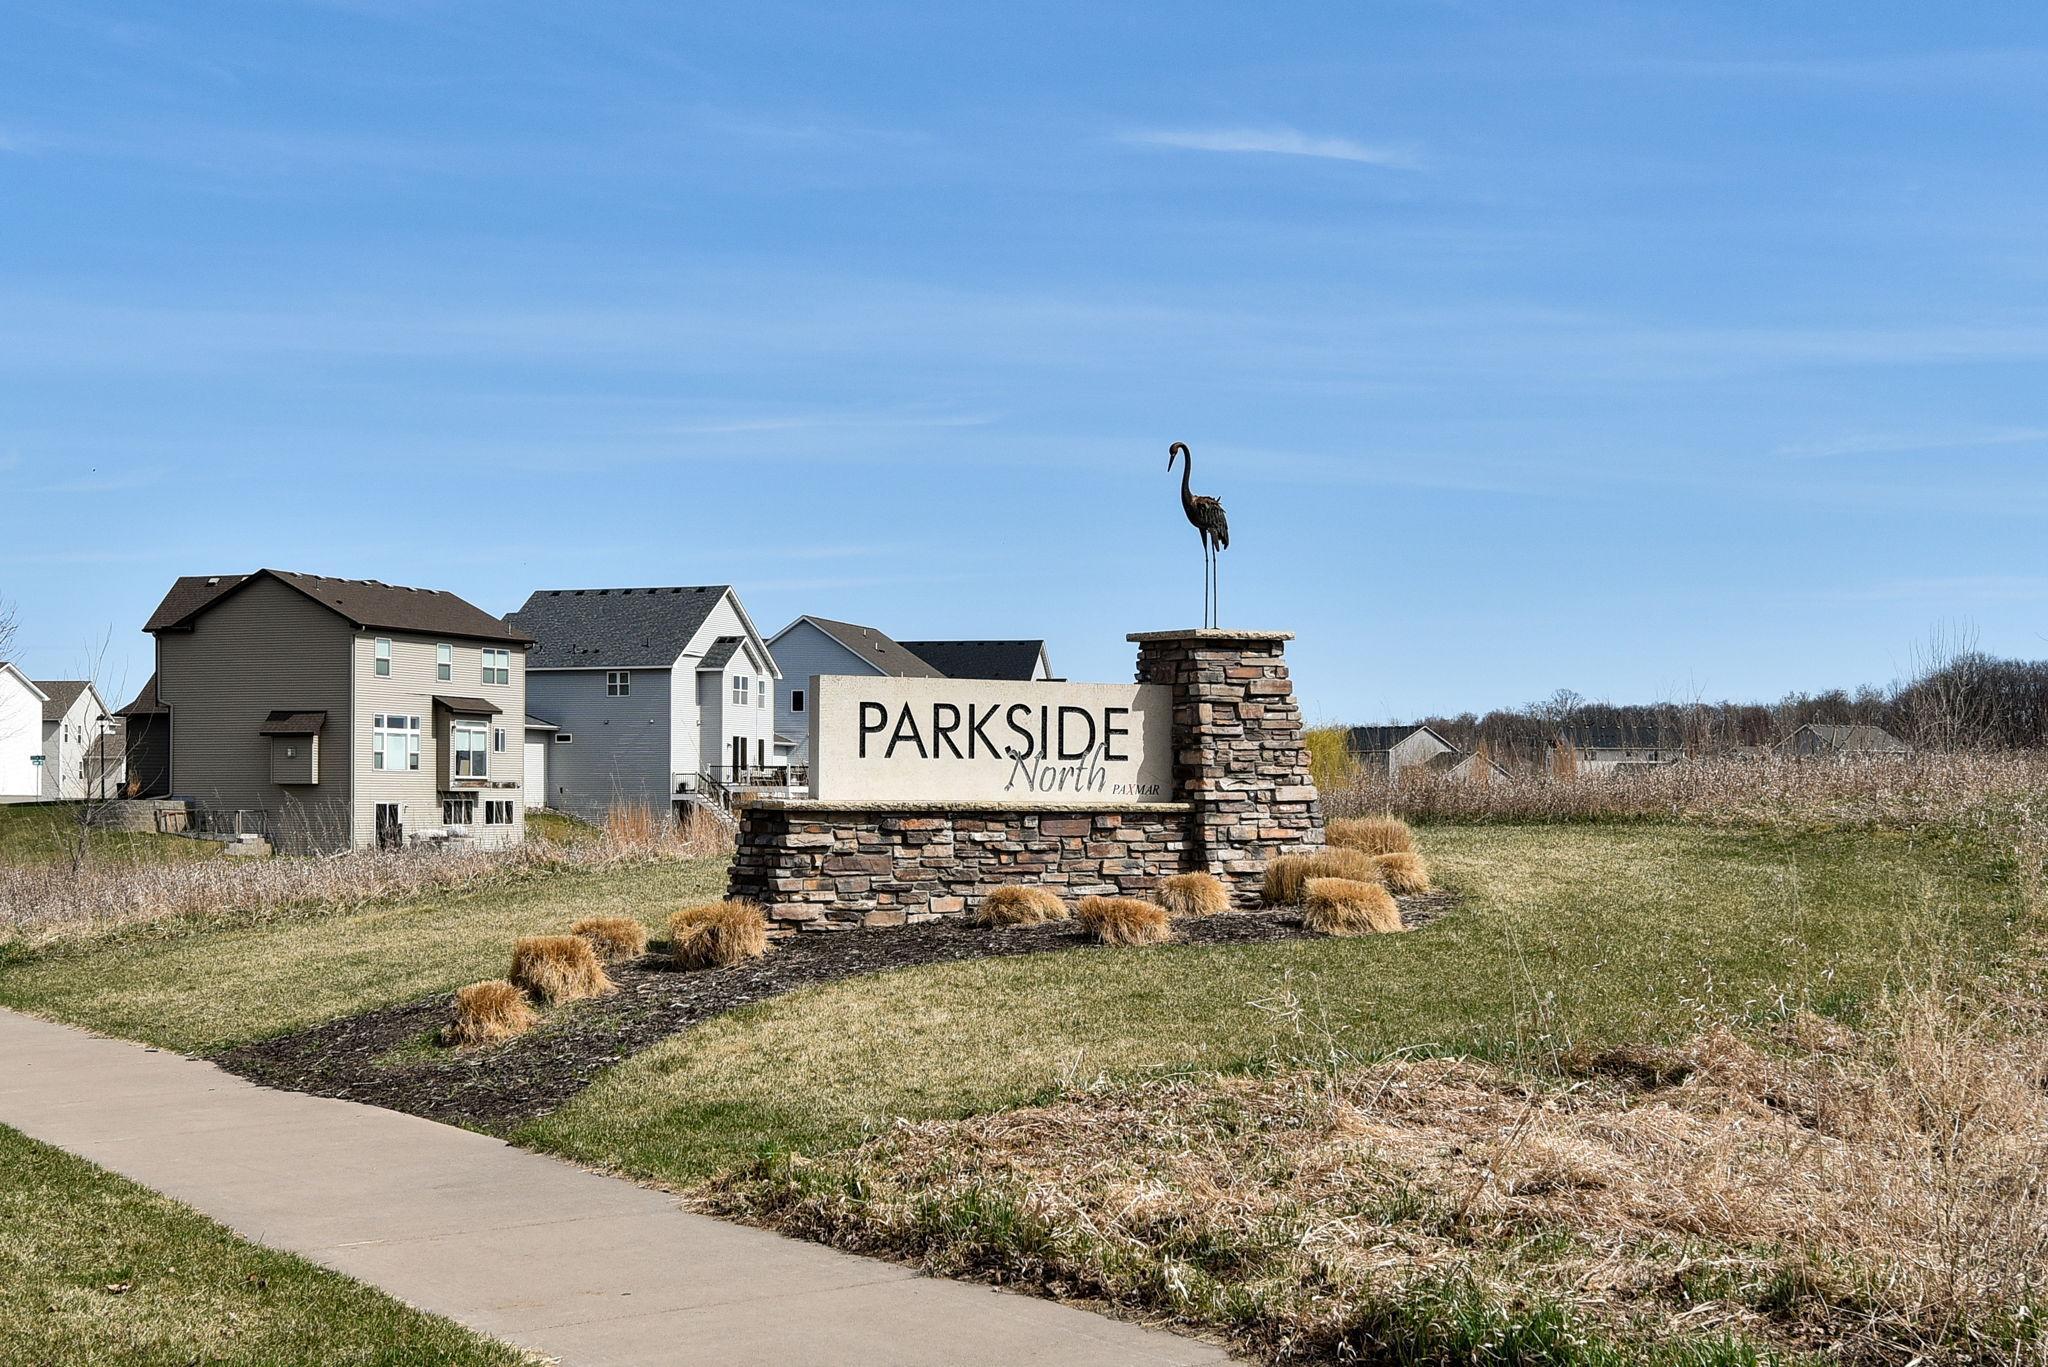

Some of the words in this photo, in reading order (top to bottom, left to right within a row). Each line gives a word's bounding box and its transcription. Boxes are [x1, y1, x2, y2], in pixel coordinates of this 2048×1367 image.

[859, 701, 1129, 761] PARKSIDE
[1004, 742, 1107, 792] North
[1112, 784, 1160, 796] PAXMAR
